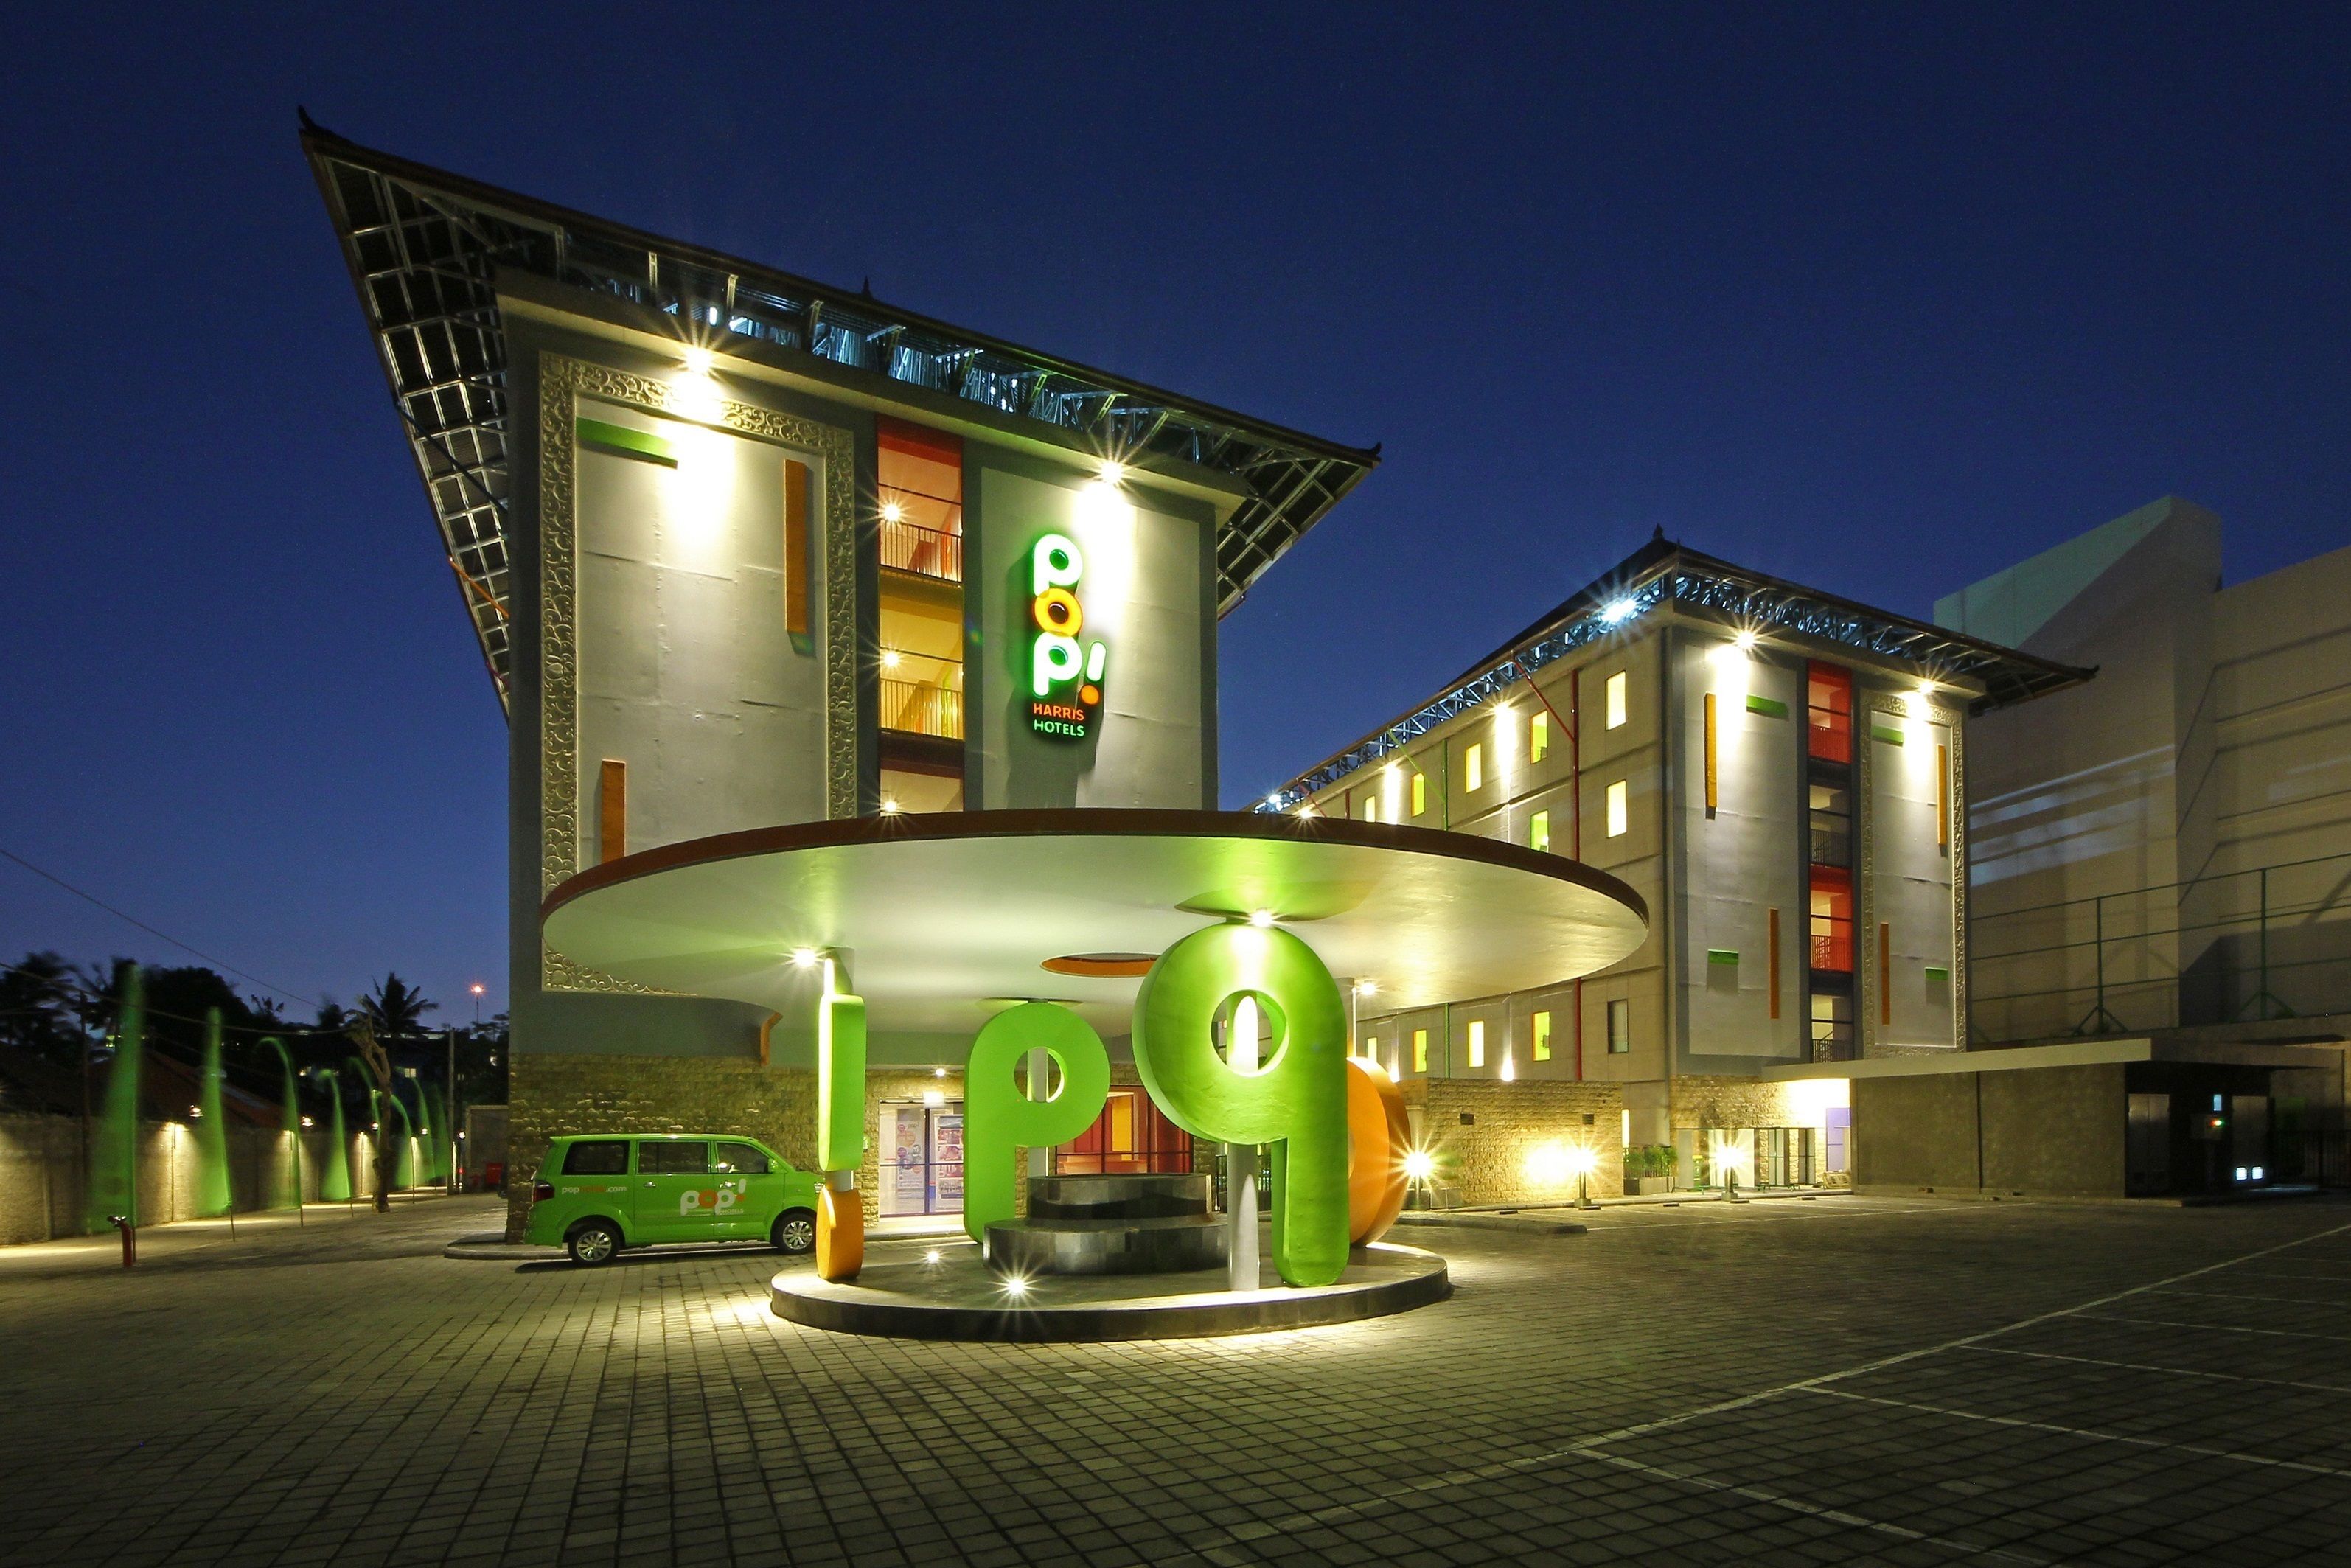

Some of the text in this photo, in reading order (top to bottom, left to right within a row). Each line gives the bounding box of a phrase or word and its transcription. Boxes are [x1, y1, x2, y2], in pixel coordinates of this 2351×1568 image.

[1033, 703, 1084, 721] HARRIS
[1034, 719, 1084, 737] HOTELS
[680, 1178, 747, 1216] pop!
